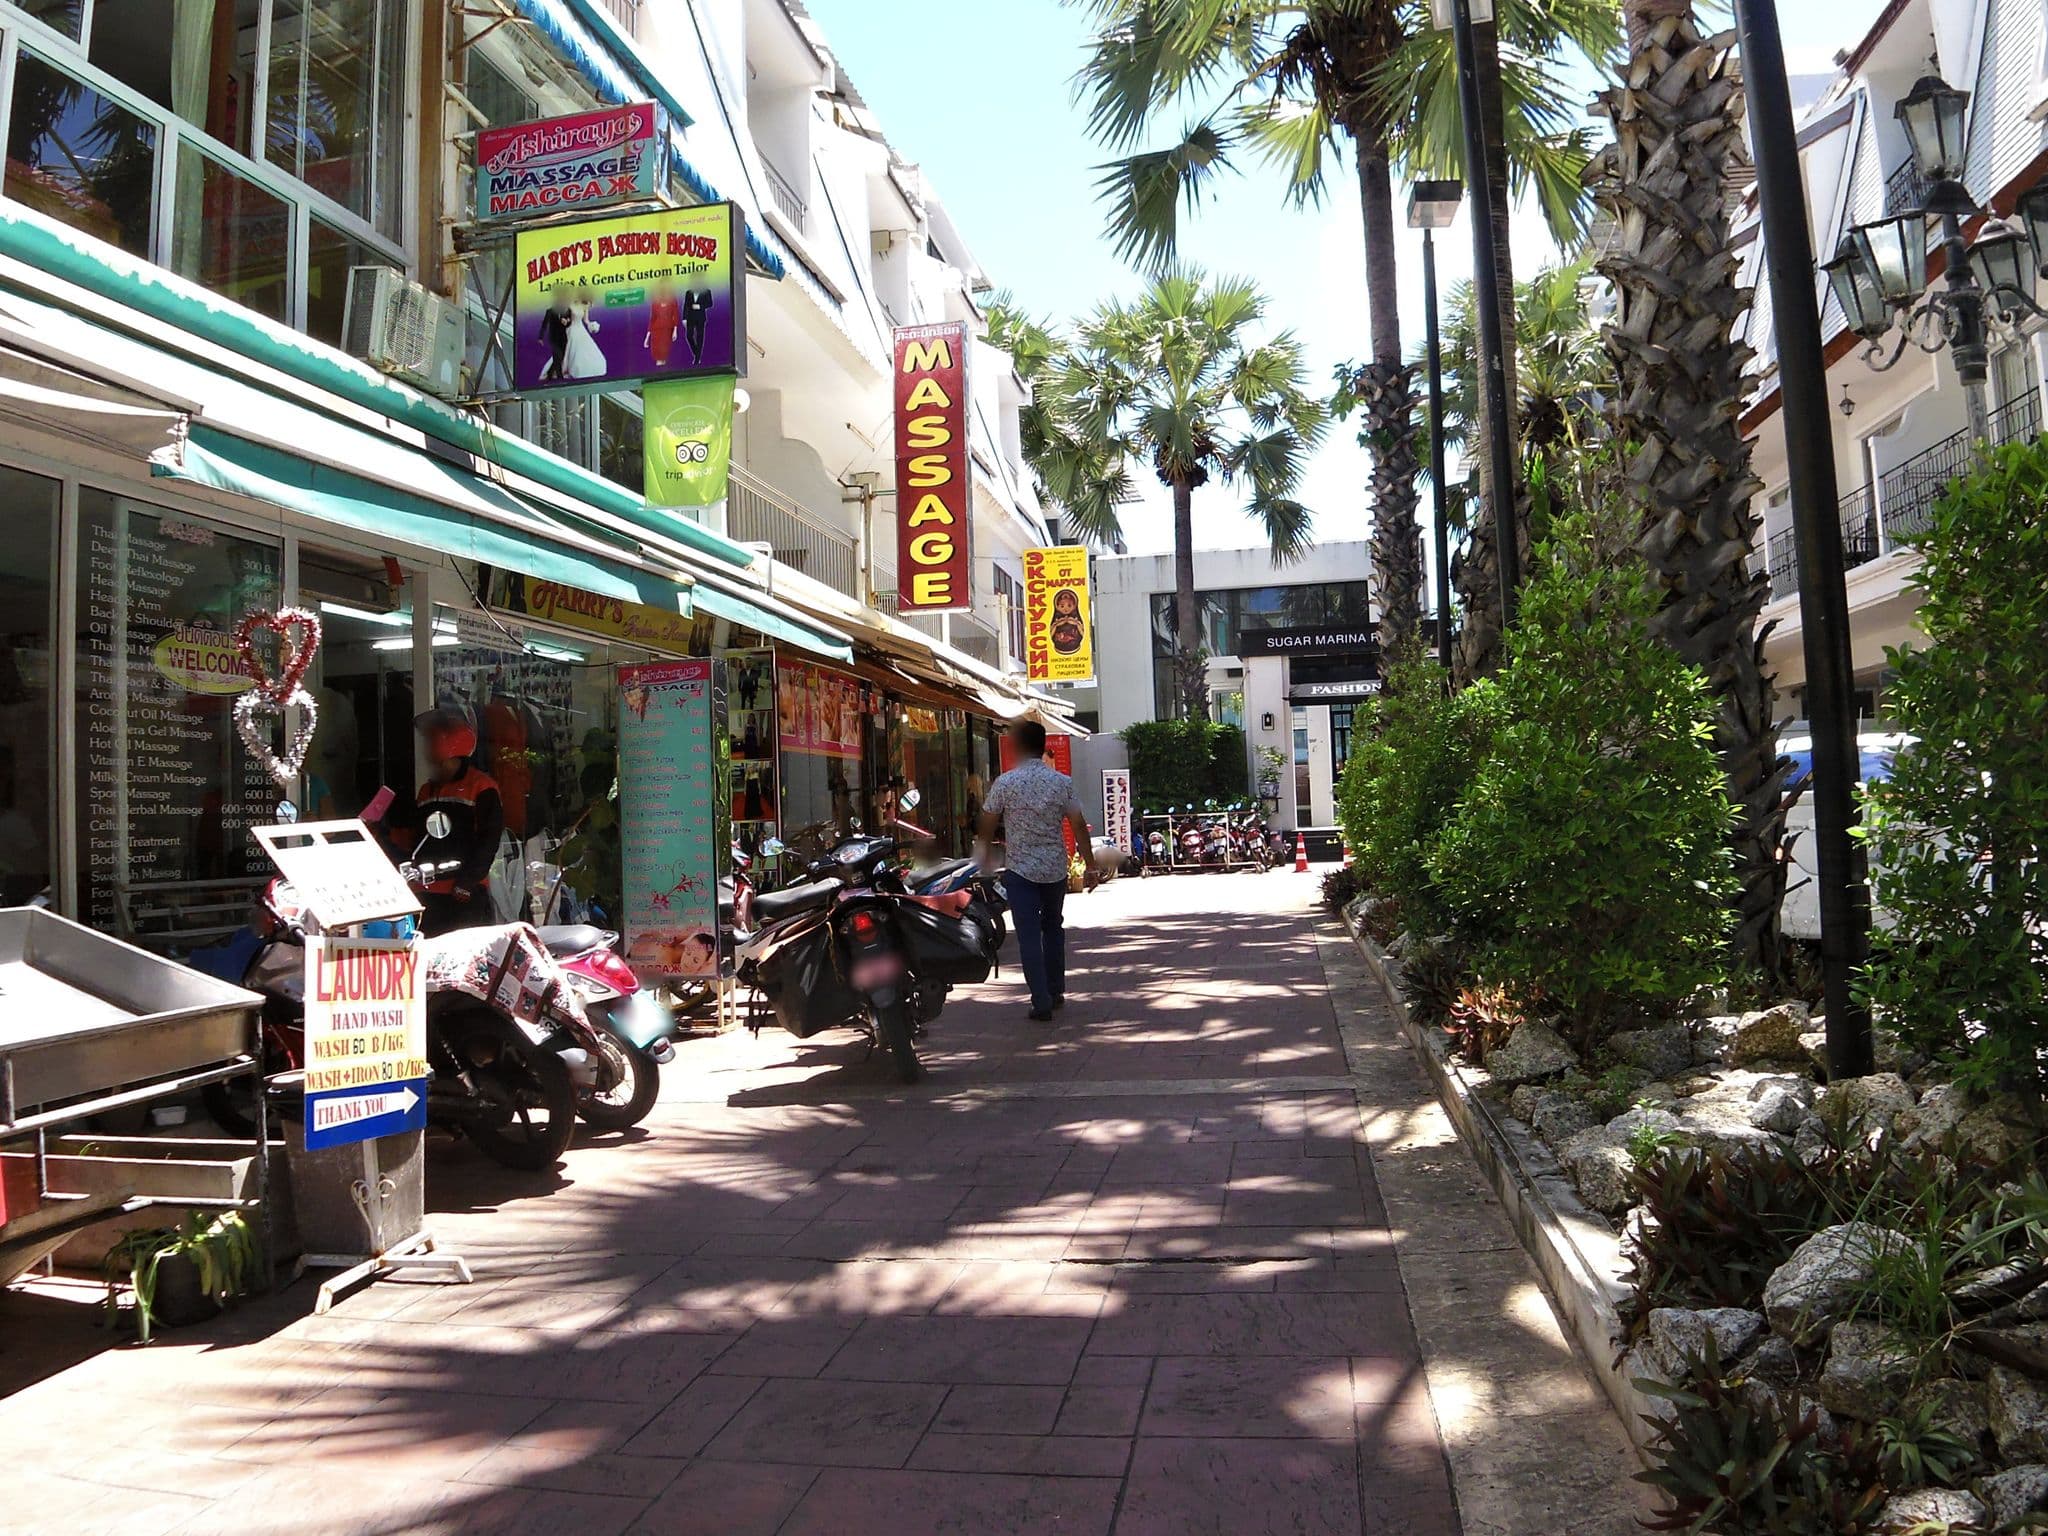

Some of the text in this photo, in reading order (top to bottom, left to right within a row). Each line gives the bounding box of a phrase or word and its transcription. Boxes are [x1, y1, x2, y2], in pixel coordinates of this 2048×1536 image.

[489, 153, 640, 194] MASSAGE
[489, 174, 640, 214] МАССАЖ
[526, 232, 717, 283] HARRY'S FASHION HOUSE
[578, 275, 588, 287] &
[592, 272, 625, 287] Gents
[627, 267, 672, 282] Custom
[675, 260, 710, 277] Tailor
[902, 338, 955, 606] MASSAGE
[152, 554, 196, 574] Massage
[1058, 568, 1073, 577] ОТ
[1025, 551, 1049, 679] ЭКСКУРСИИ
[89, 621, 107, 635] Oil
[110, 624, 157, 643] Mssage
[1266, 636, 1312, 648] SUGAR
[1315, 633, 1367, 646] MARINA
[89, 654, 115, 668] Tha
[89, 670, 115, 684] Tha
[132, 692, 177, 707] Massage
[89, 703, 138, 718] Cocout
[141, 708, 157, 720] Oil
[160, 709, 204, 724] Massage
[125, 724, 145, 735] era
[148, 725, 167, 737] Gel
[170, 728, 213, 742] Massage
[89, 737, 112, 749] Hot
[134, 740, 180, 754] Massage
[89, 754, 134, 767] Vitamn
[137, 756, 146, 767] E
[149, 757, 192, 770] Massage
[163, 773, 207, 786] Massage
[244, 775, 263, 785] 600
[89, 786, 118, 800] Spor
[244, 789, 264, 800] 600
[160, 804, 204, 817] Massage
[221, 804, 264, 815] 600-900
[1105, 777, 1117, 844] ЭКСКУРС
[90, 837, 121, 849] Facia
[246, 848, 265, 857] 600
[246, 862, 265, 872] 600
[91, 887, 116, 899] Foo
[316, 947, 419, 1002] LAUNDRY
[332, 1010, 404, 1032] HAND WASH
[313, 1037, 350, 1058] WASH
[352, 1037, 366, 1055] 60
[381, 1060, 394, 1081] 80
[315, 1095, 388, 1126] THANK YOU
